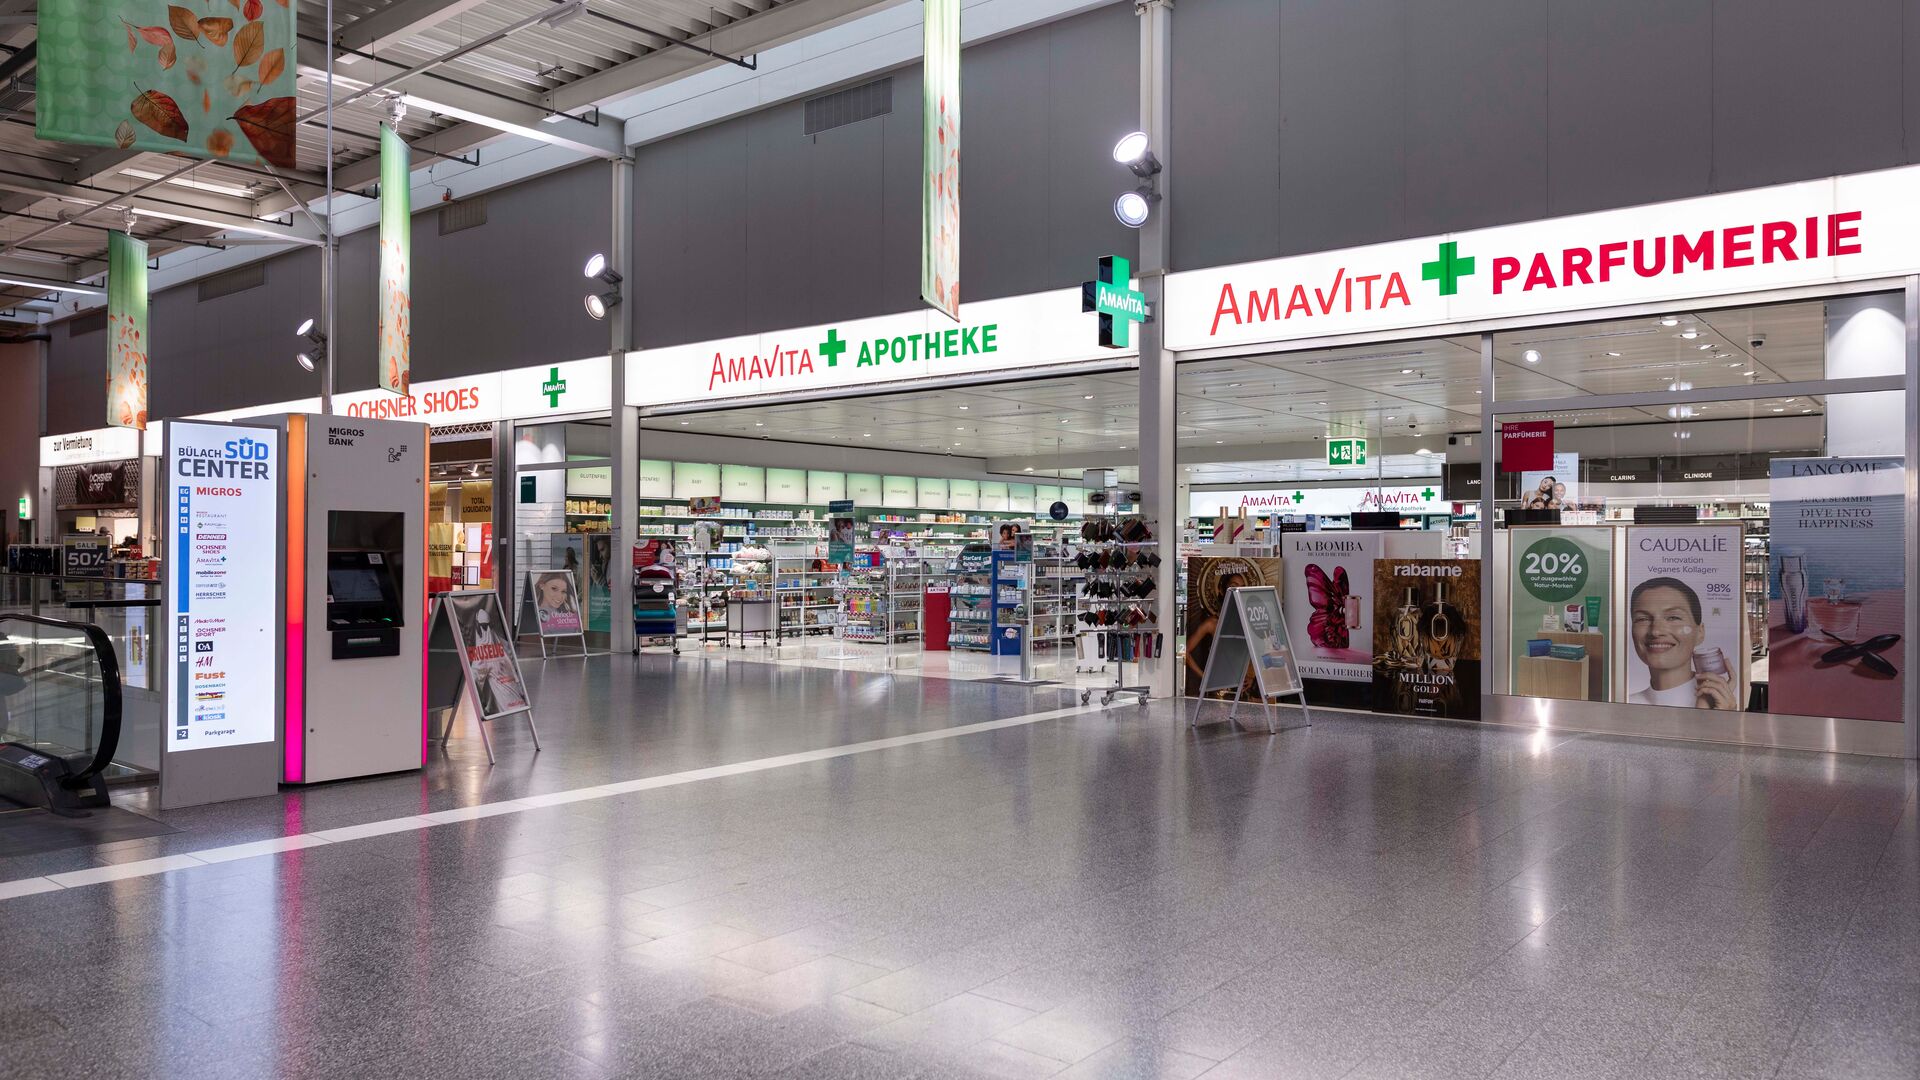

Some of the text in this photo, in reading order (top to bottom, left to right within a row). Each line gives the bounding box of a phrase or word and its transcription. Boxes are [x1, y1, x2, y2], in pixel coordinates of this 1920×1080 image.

[1210, 210, 1862, 336] AMAVITA PARFUMERIE
[1099, 287, 1143, 315] AMAVITA
[709, 324, 998, 391] AMAVITA APOTHEKE
[347, 387, 479, 419] OCHSNER SHOES
[329, 427, 364, 438] MIGROS
[1504, 431, 1547, 439] PARFÜMERIE
[53, 436, 93, 452] zur Vermietung
[178, 437, 269, 461] BÜLACH SÜD
[329, 438, 354, 447] BANK
[178, 458, 270, 480] CENTER
[196, 487, 242, 497] MIGROS
[1362, 491, 1419, 504] AMAVITA
[470, 497, 485, 505] TOTAL
[1241, 494, 1290, 507] AMAVITA
[1829, 495, 1873, 503] SUMMER
[1801, 508, 1872, 518] DIVE INTO
[1798, 519, 1874, 528] HAPPINESS
[1296, 541, 1363, 552] LA BOMBA
[1639, 534, 1728, 552] CAUDALÍE
[68, 552, 105, 566] 50%
[1525, 552, 1583, 575] 20%
[1662, 556, 1704, 564] Innovation
[1393, 563, 1463, 577] rabanne
[1647, 566, 1717, 575] Veganes Kollagen
[1541, 576, 1577, 584] ausgewählte
[1706, 583, 1731, 593] 98%
[1248, 606, 1269, 622] 20%
[1298, 665, 1374, 678] ROLINA HERRER
[1399, 672, 1454, 686] MILLION
[1413, 685, 1440, 694] GOLD
[178, 730, 187, 738] -2
